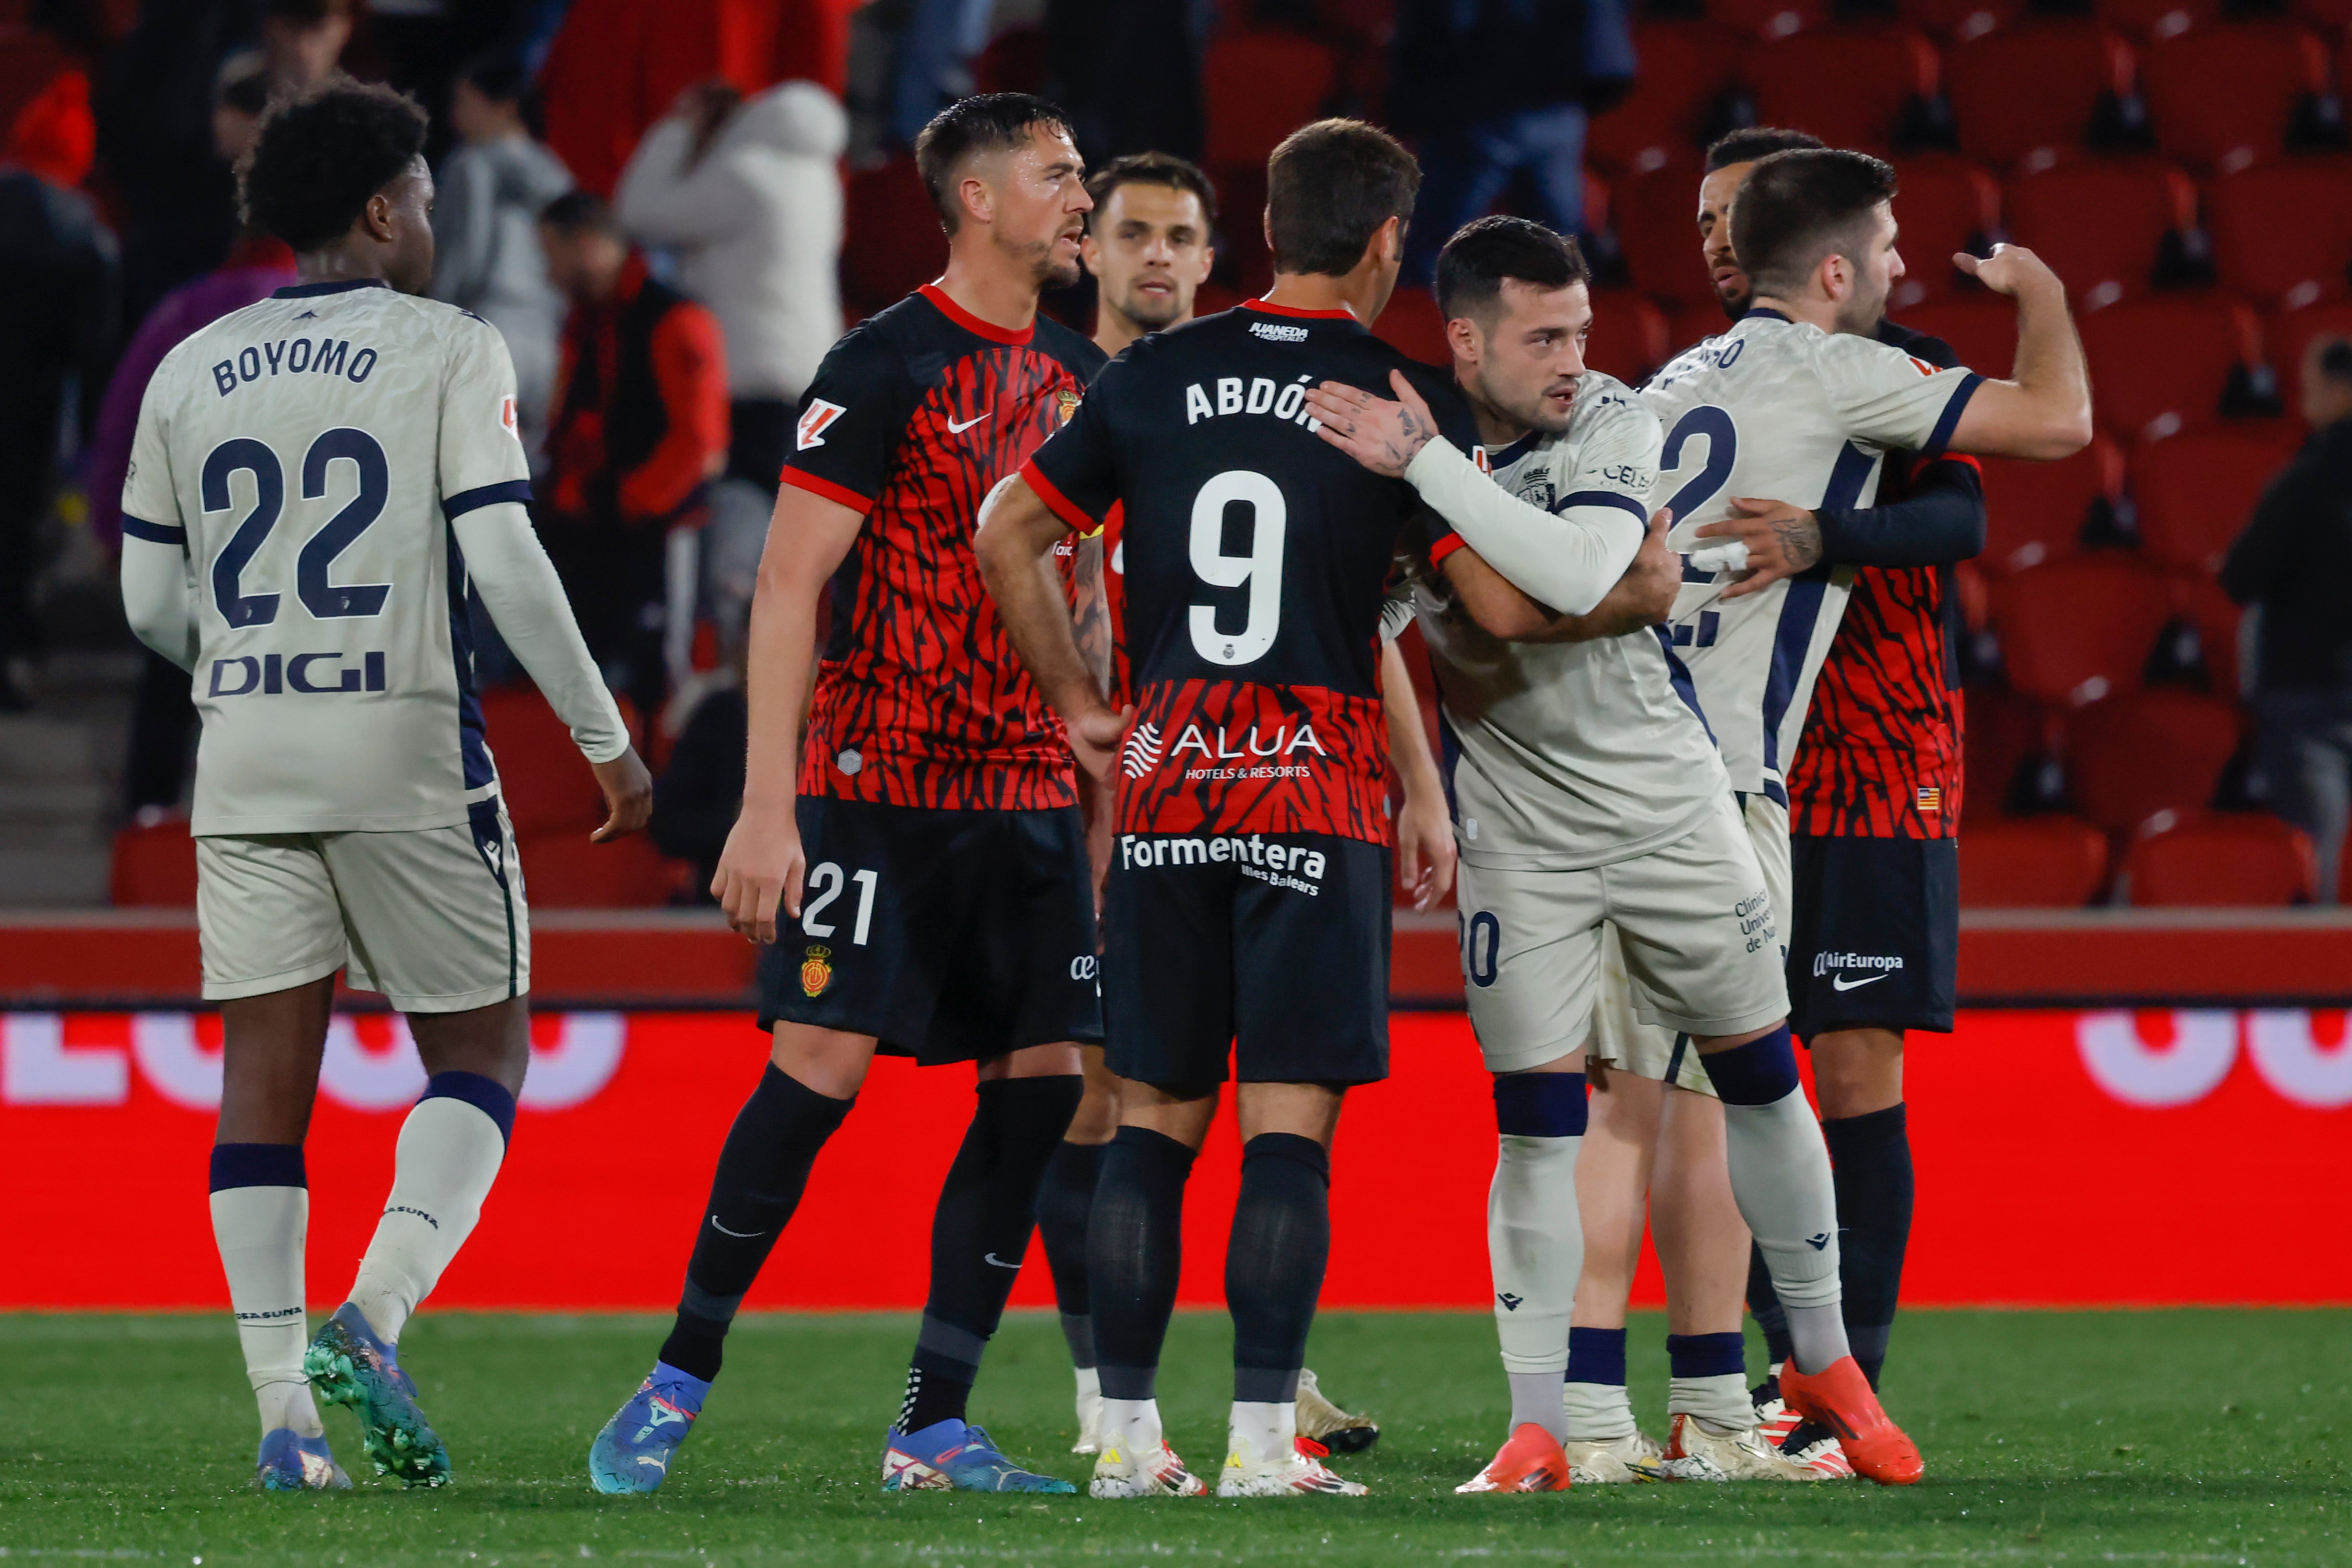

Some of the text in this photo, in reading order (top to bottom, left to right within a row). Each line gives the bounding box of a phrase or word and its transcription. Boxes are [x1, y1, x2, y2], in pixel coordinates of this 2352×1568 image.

[1248, 322, 1309, 338] JUANEDA
[1260, 333, 1306, 342] HOSPITALES
[212, 338, 378, 398] BOYOMO
[201, 425, 394, 632] 22
[1188, 470, 1287, 666] 9
[208, 651, 386, 699] DIGI
[1171, 724, 1327, 759] ALUA
[1185, 766, 1311, 779] HOTELS & RESORTS
[1120, 834, 1327, 880] Formentera
[1241, 864, 1319, 896] Illes Balears
[801, 861, 878, 946] 21
[1458, 909, 1500, 989] 0
[1746, 937, 1762, 953] de
